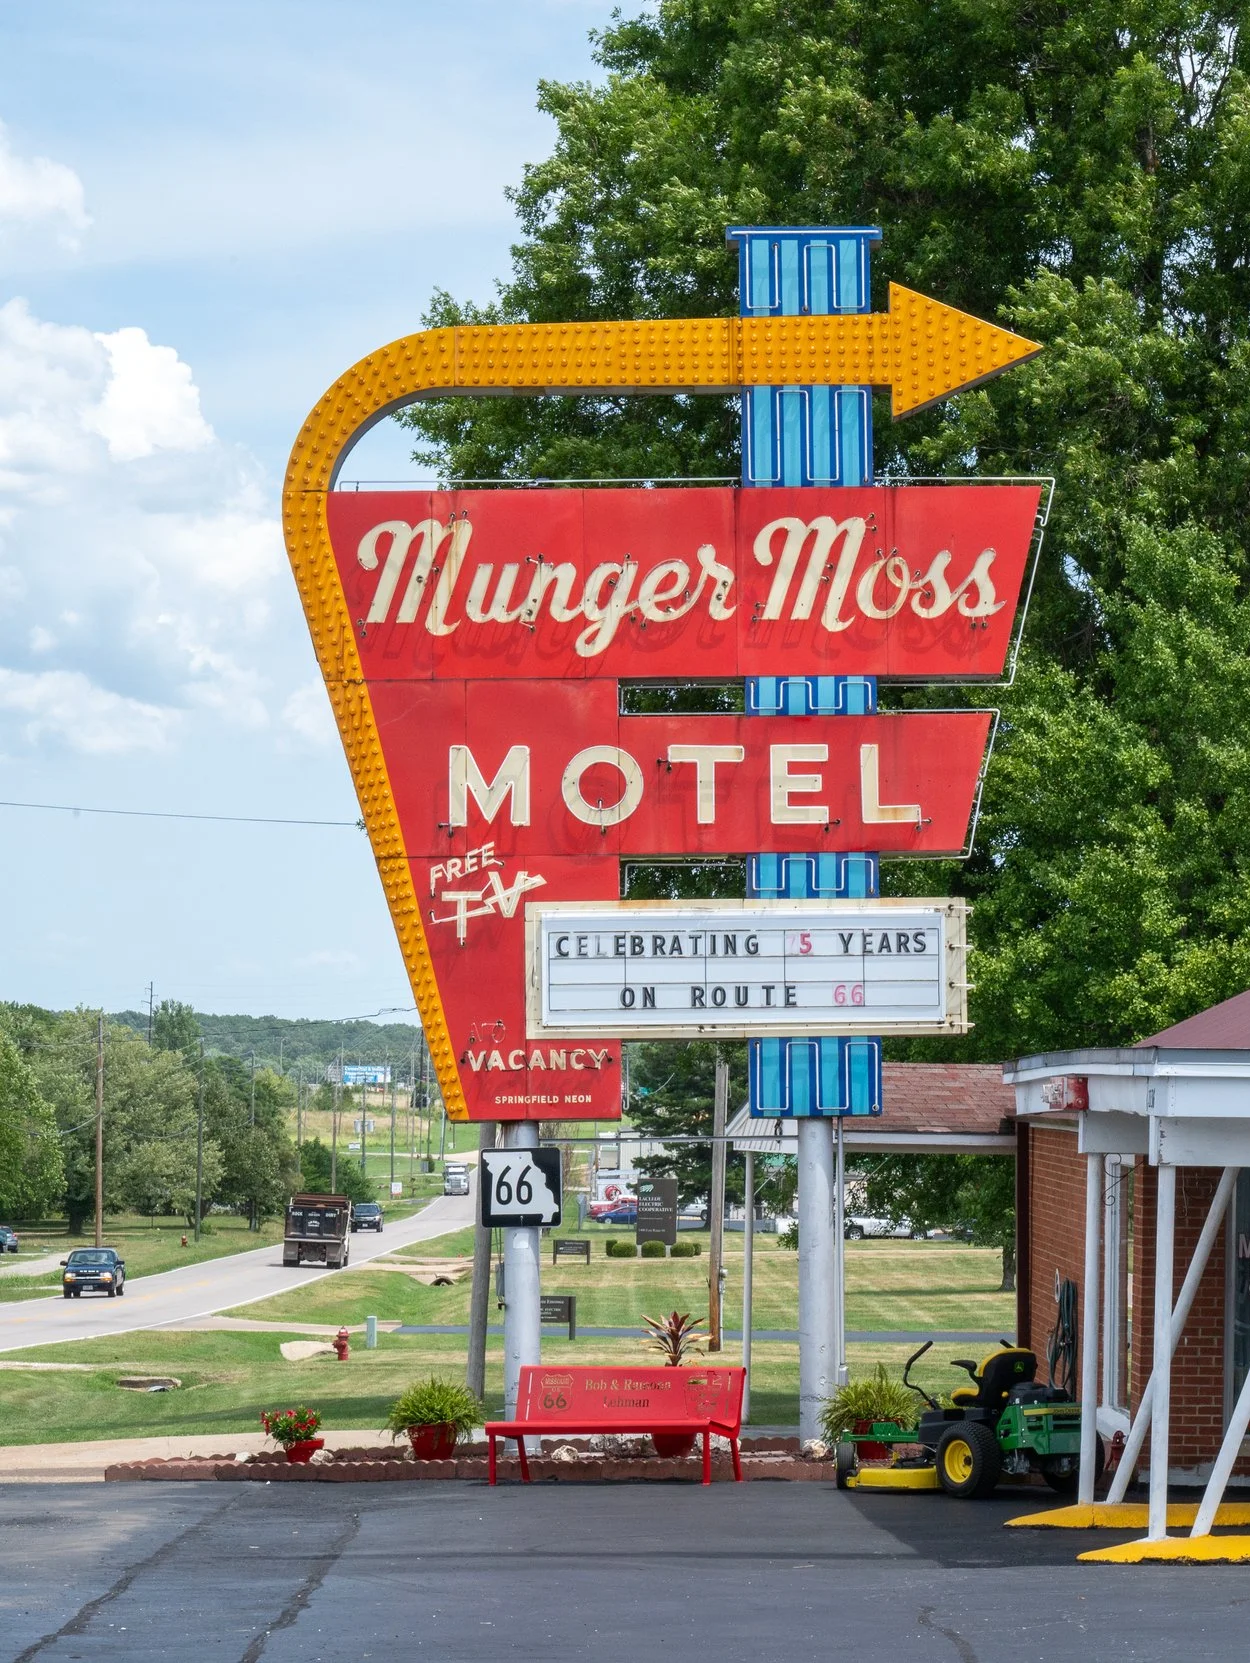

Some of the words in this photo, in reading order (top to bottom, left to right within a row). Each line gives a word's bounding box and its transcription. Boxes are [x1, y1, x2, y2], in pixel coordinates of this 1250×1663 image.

[357, 516, 738, 658] Munger
[753, 515, 1006, 633] Moss
[448, 743, 922, 828] MOTEL
[430, 841, 495, 890] FREE
[440, 870, 534, 939] TV
[555, 933, 760, 957] CELEBRATING
[838, 930, 927, 954] YEARS
[620, 986, 656, 1008] ON
[691, 984, 798, 1008] ROUTE
[833, 983, 864, 1005] 66
[468, 1048, 609, 1072] VACANCY
[494, 1096, 560, 1105] SPRINGFIELD
[564, 1094, 592, 1103] NEON
[495, 1164, 533, 1206] 66
[584, 1379, 607, 1391] Bob
[610, 1379, 620, 1391] &
[543, 1392, 567, 1410] 66
[603, 1396, 650, 1408] Lehman
